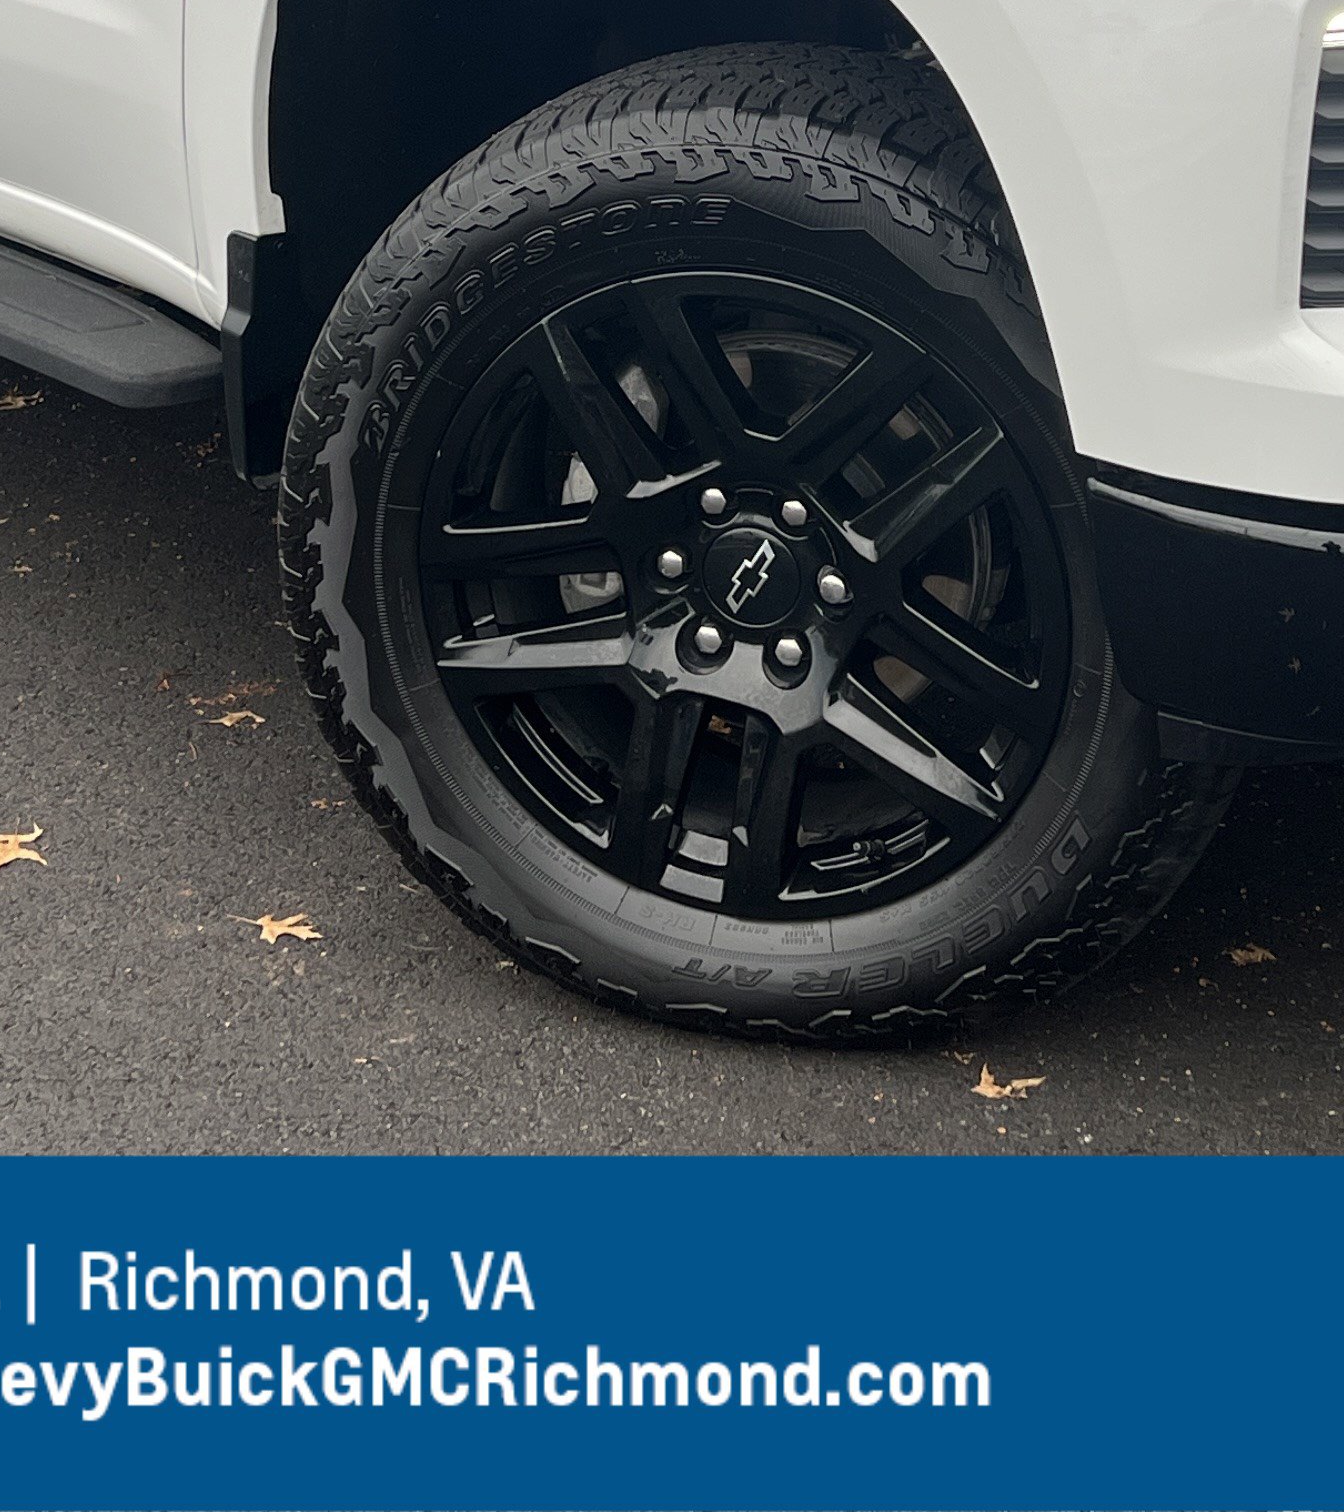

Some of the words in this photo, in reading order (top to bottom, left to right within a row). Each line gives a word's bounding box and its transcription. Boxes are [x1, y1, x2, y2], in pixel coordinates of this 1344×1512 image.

[360, 193, 733, 455] BRIDGESTONE
[672, 957, 774, 988] A/T
[792, 810, 1093, 1000] DUELER
